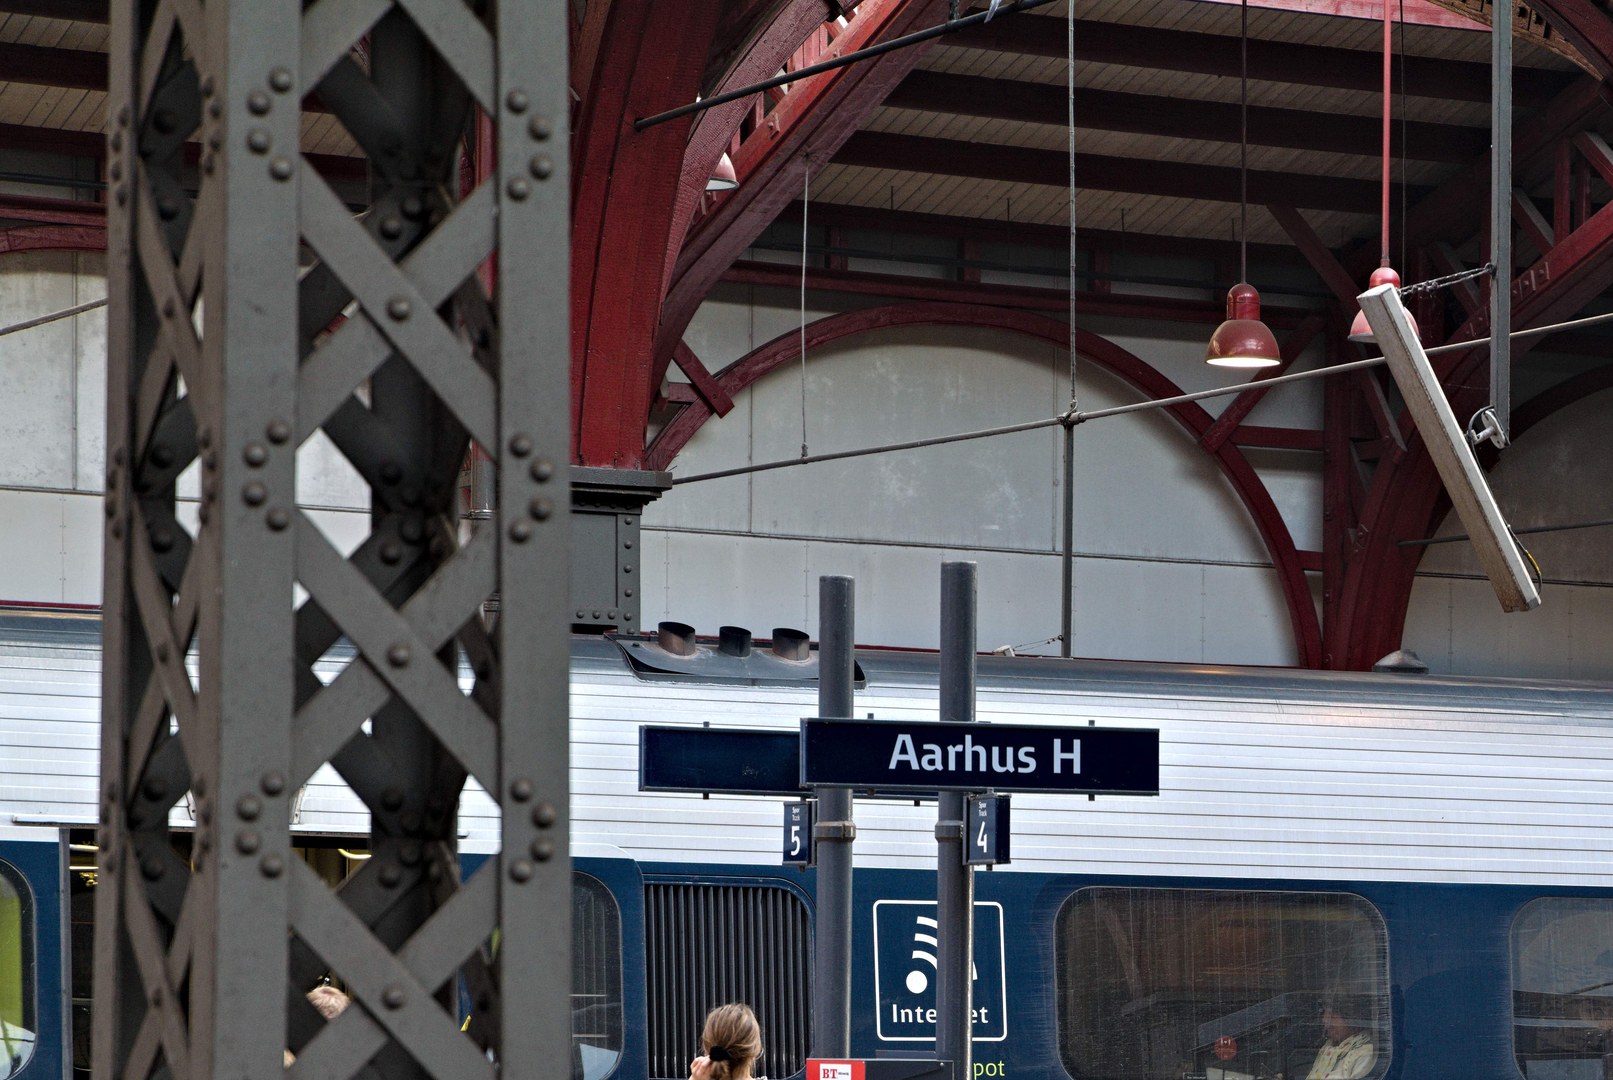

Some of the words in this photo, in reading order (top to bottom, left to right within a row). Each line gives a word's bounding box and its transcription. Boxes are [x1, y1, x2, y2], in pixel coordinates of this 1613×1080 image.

[889, 734, 1037, 774] Aarhus
[1053, 738, 1081, 774] H
[978, 809, 987, 817] Track
[790, 825, 801, 856] 5
[977, 821, 988, 853] 4
[892, 1004, 989, 1023] Inteet
[822, 1068, 837, 1079] BT
